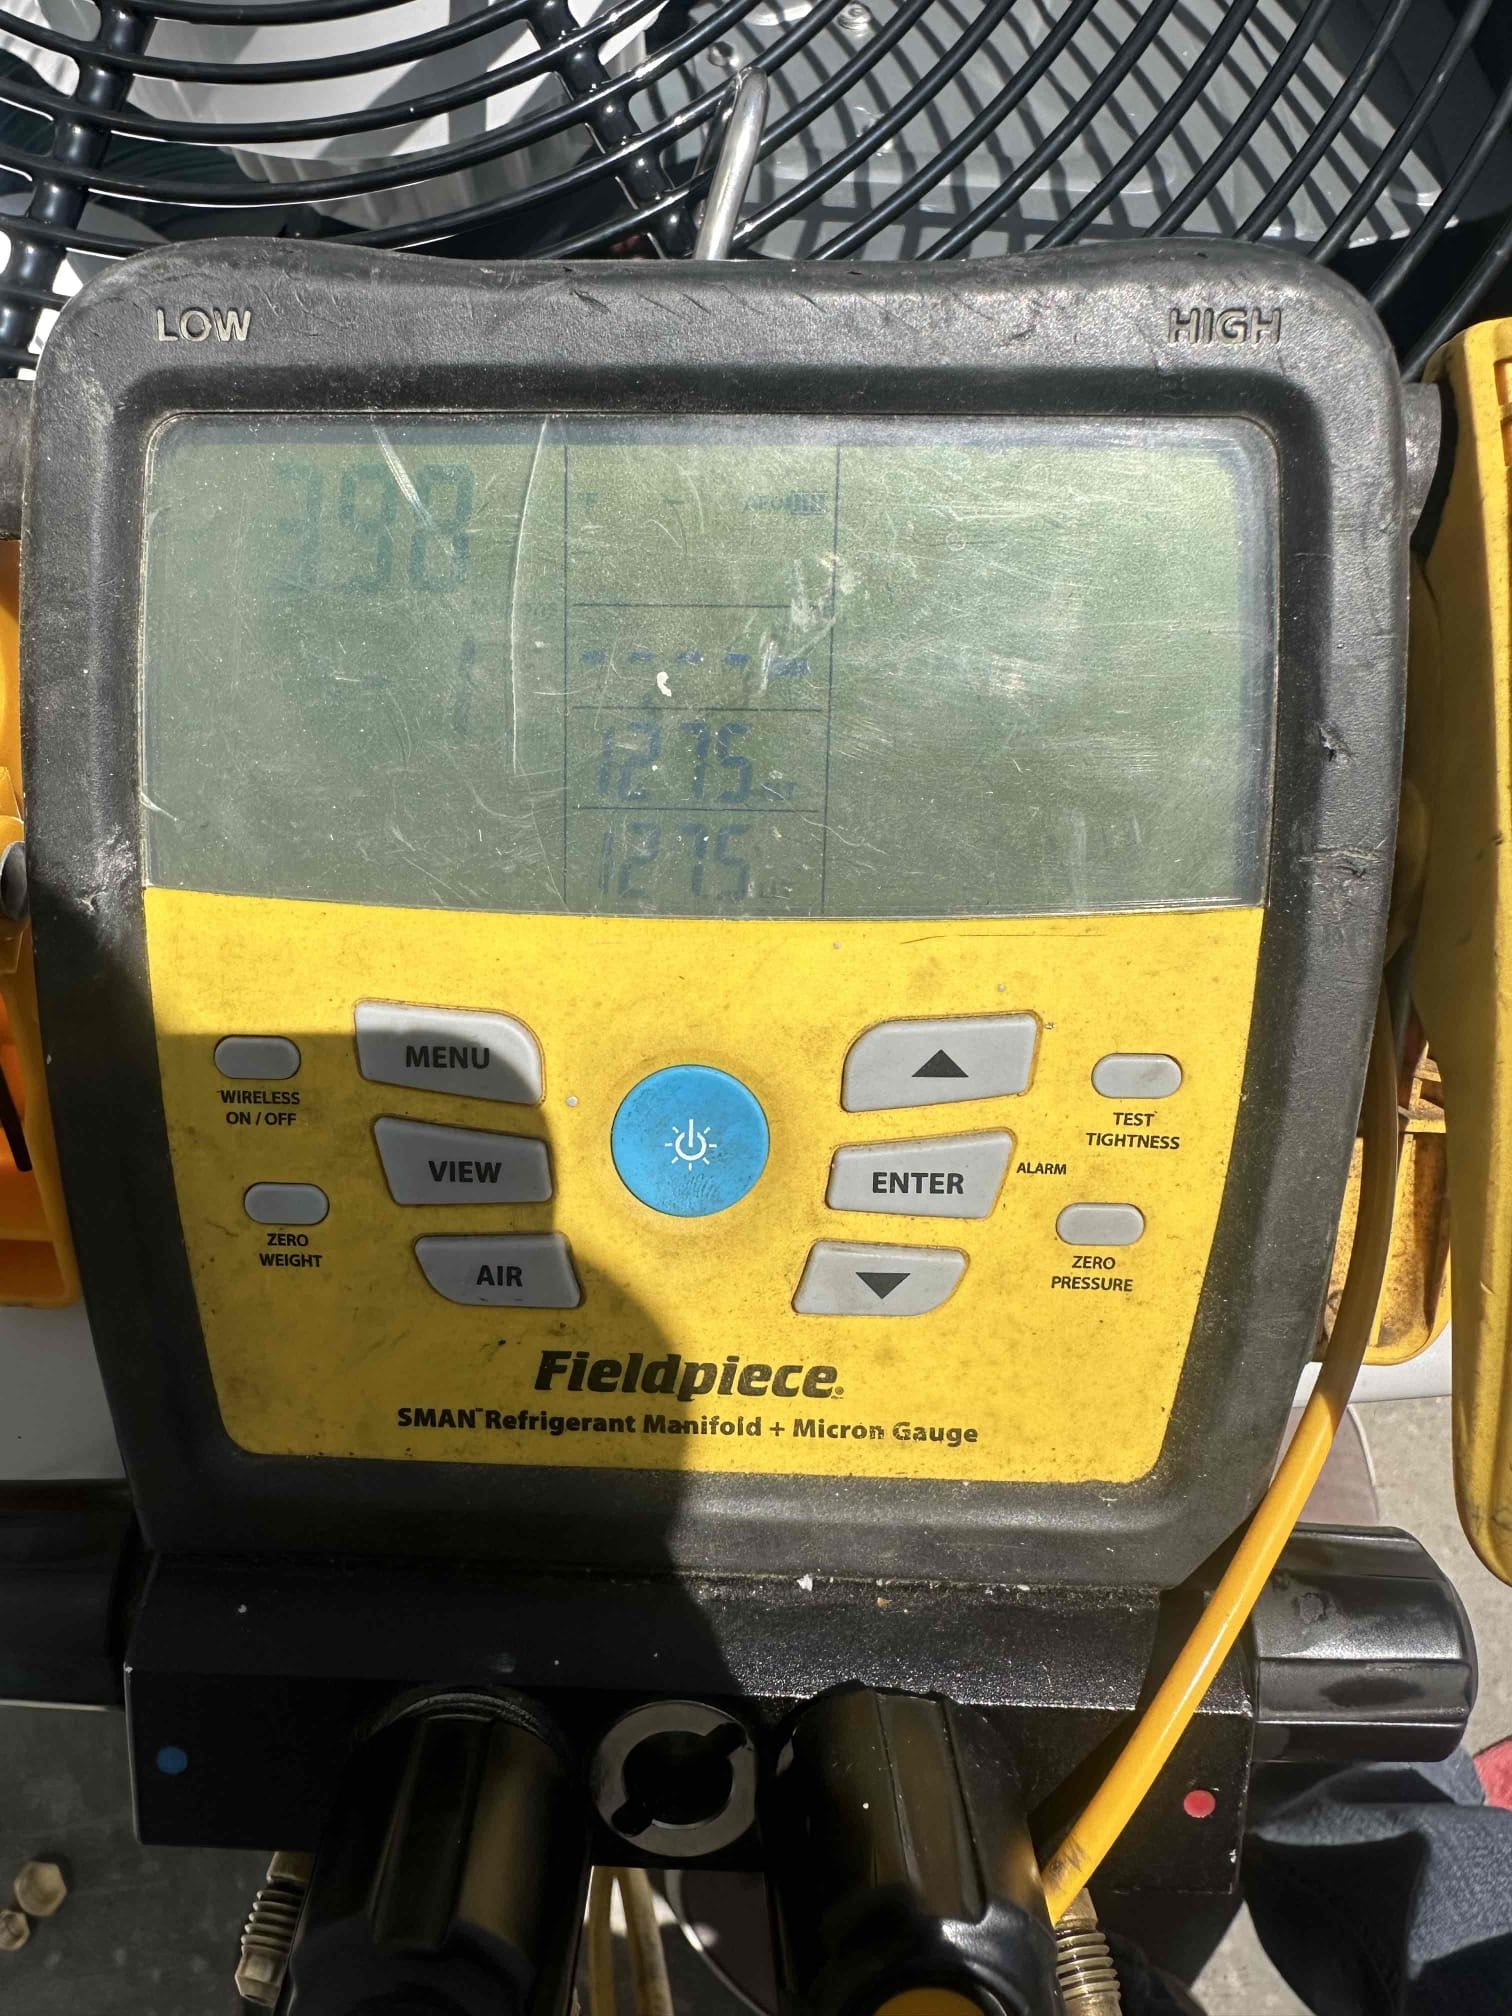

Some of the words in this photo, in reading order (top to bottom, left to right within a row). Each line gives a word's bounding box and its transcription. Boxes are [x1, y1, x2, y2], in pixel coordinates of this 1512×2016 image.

[156, 306, 252, 341] LOW
[1169, 306, 1281, 344] HIGH
[405, 1046, 490, 1069] MENU
[221, 1091, 300, 1105] WIRELESS
[226, 1112, 250, 1126] ON
[264, 1112, 297, 1126] OFF
[1113, 1112, 1154, 1127] TEST
[1086, 1133, 1180, 1149] TIGHTNESS
[428, 1160, 502, 1183] VIEW
[1016, 1162, 1067, 1176] ALARM
[872, 1172, 964, 1195] ENTER
[267, 1233, 308, 1247] ZERO
[259, 1254, 322, 1267] WEIGHT
[1072, 1256, 1116, 1270] ZERO
[476, 1265, 523, 1287] AIR
[1051, 1277, 1133, 1292] PRESSURE
[485, 1410, 635, 1435] Refrigerant
[643, 1415, 762, 1437] Manifold
[792, 1418, 885, 1440] Micron
[892, 1421, 979, 1447] Gauge
